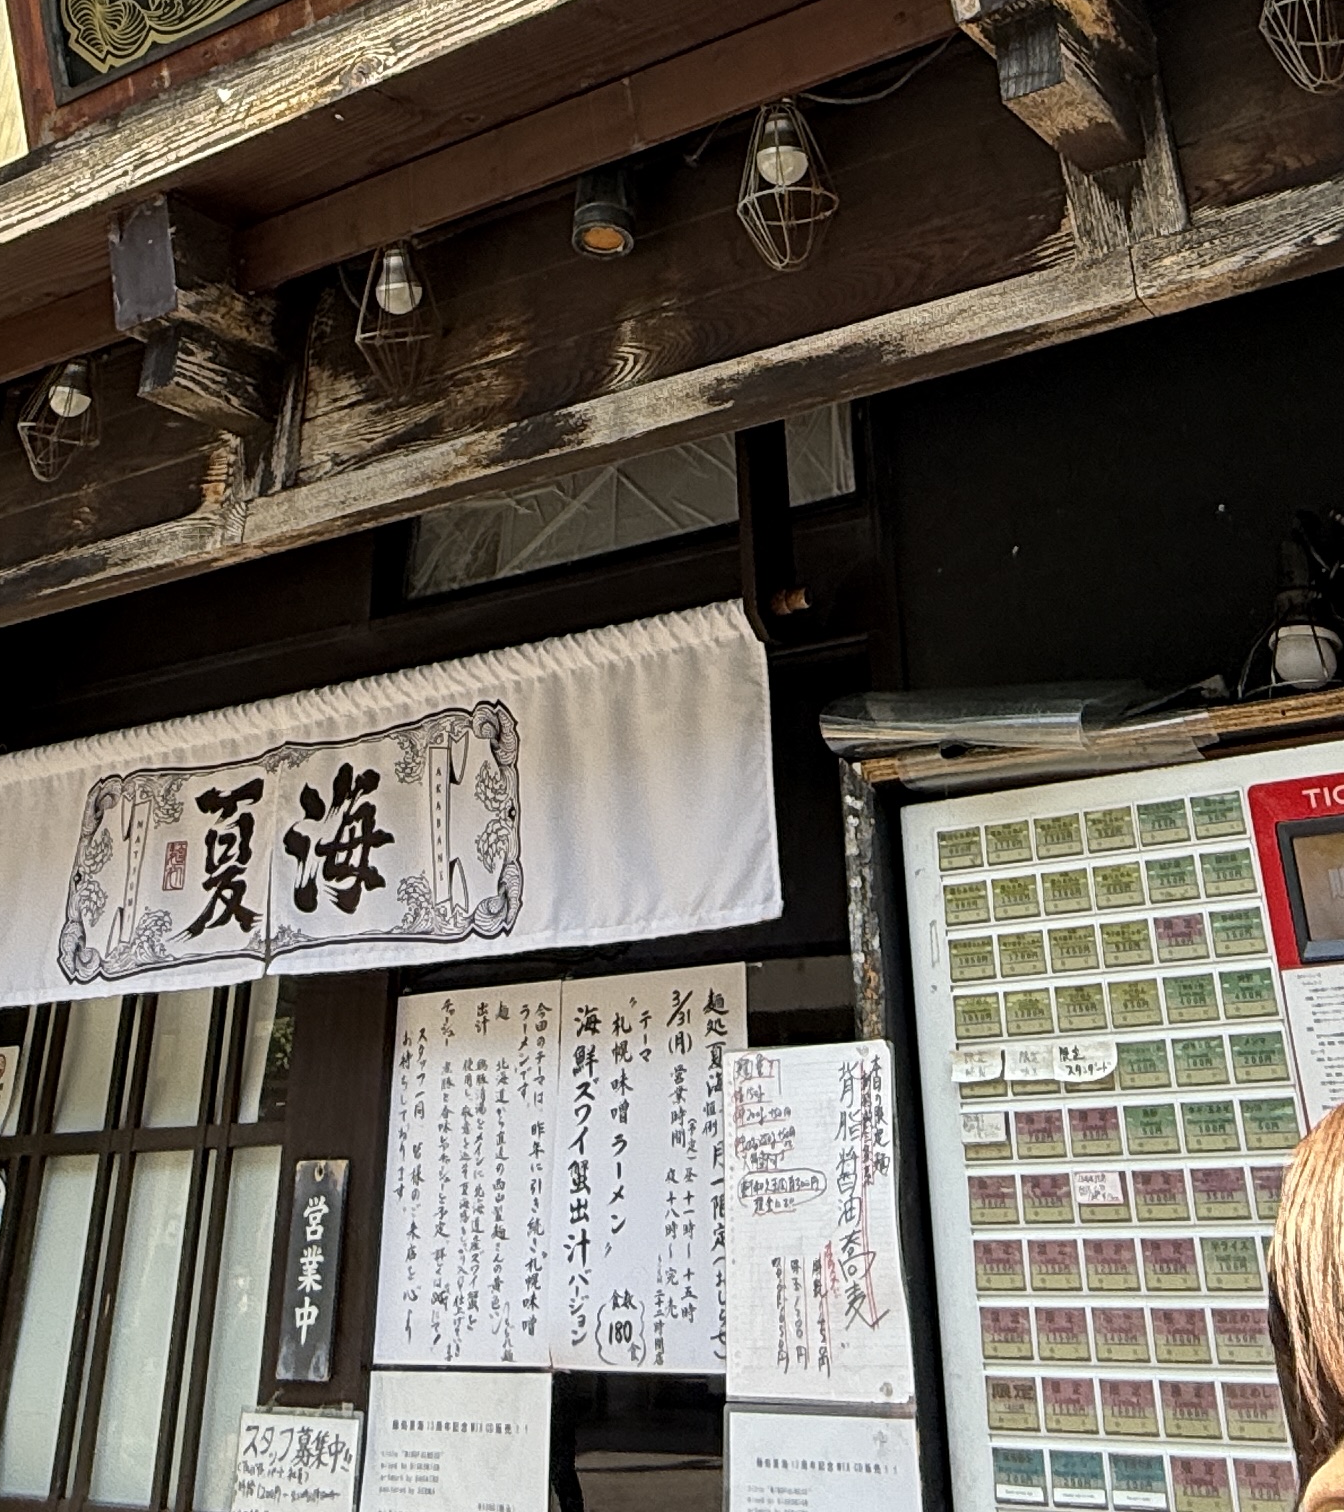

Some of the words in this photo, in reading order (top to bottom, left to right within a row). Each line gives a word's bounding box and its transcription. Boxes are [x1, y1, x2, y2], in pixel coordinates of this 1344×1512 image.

[170, 761, 395, 943] 夏海
[639, 1010, 652, 1063] テーマ
[666, 989, 693, 1055] 3/31(月)
[563, 1004, 602, 1347] 海鮮ズワイ蟹出汁バージョン
[293, 1195, 330, 1347] 営業中
[608, 1320, 633, 1346] 180
